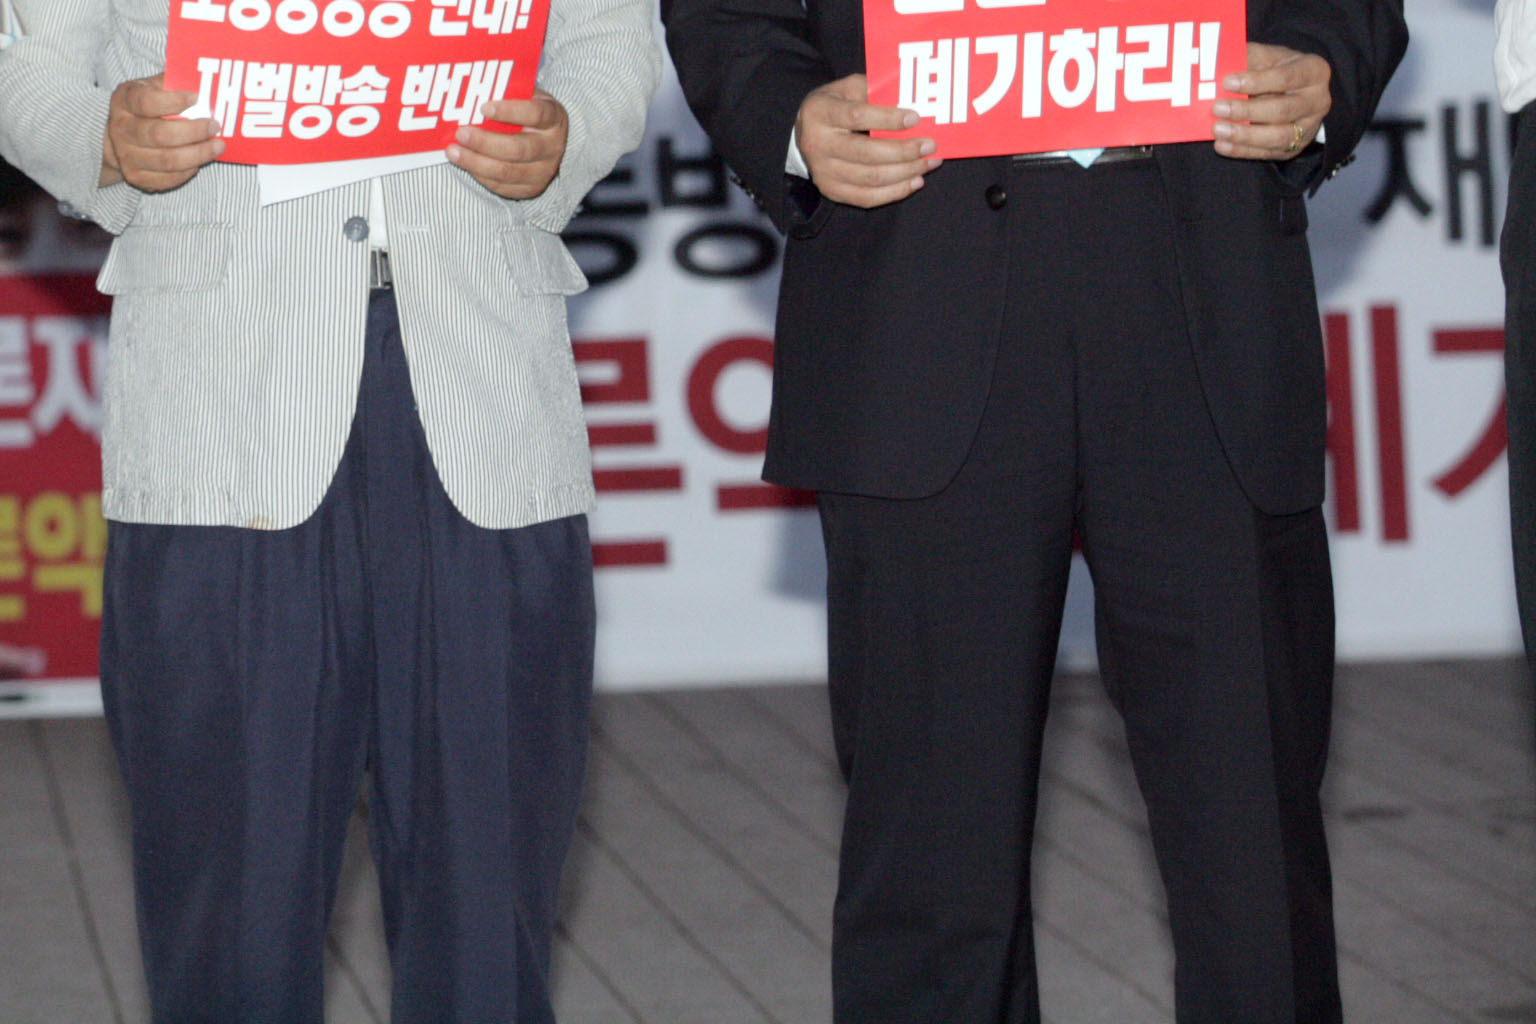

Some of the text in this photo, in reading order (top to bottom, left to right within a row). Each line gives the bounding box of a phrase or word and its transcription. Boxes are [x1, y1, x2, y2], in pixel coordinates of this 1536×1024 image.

[195, 57, 514, 139] 재벌방송 반대!
[896, 21, 1221, 125] 폐기하라!
